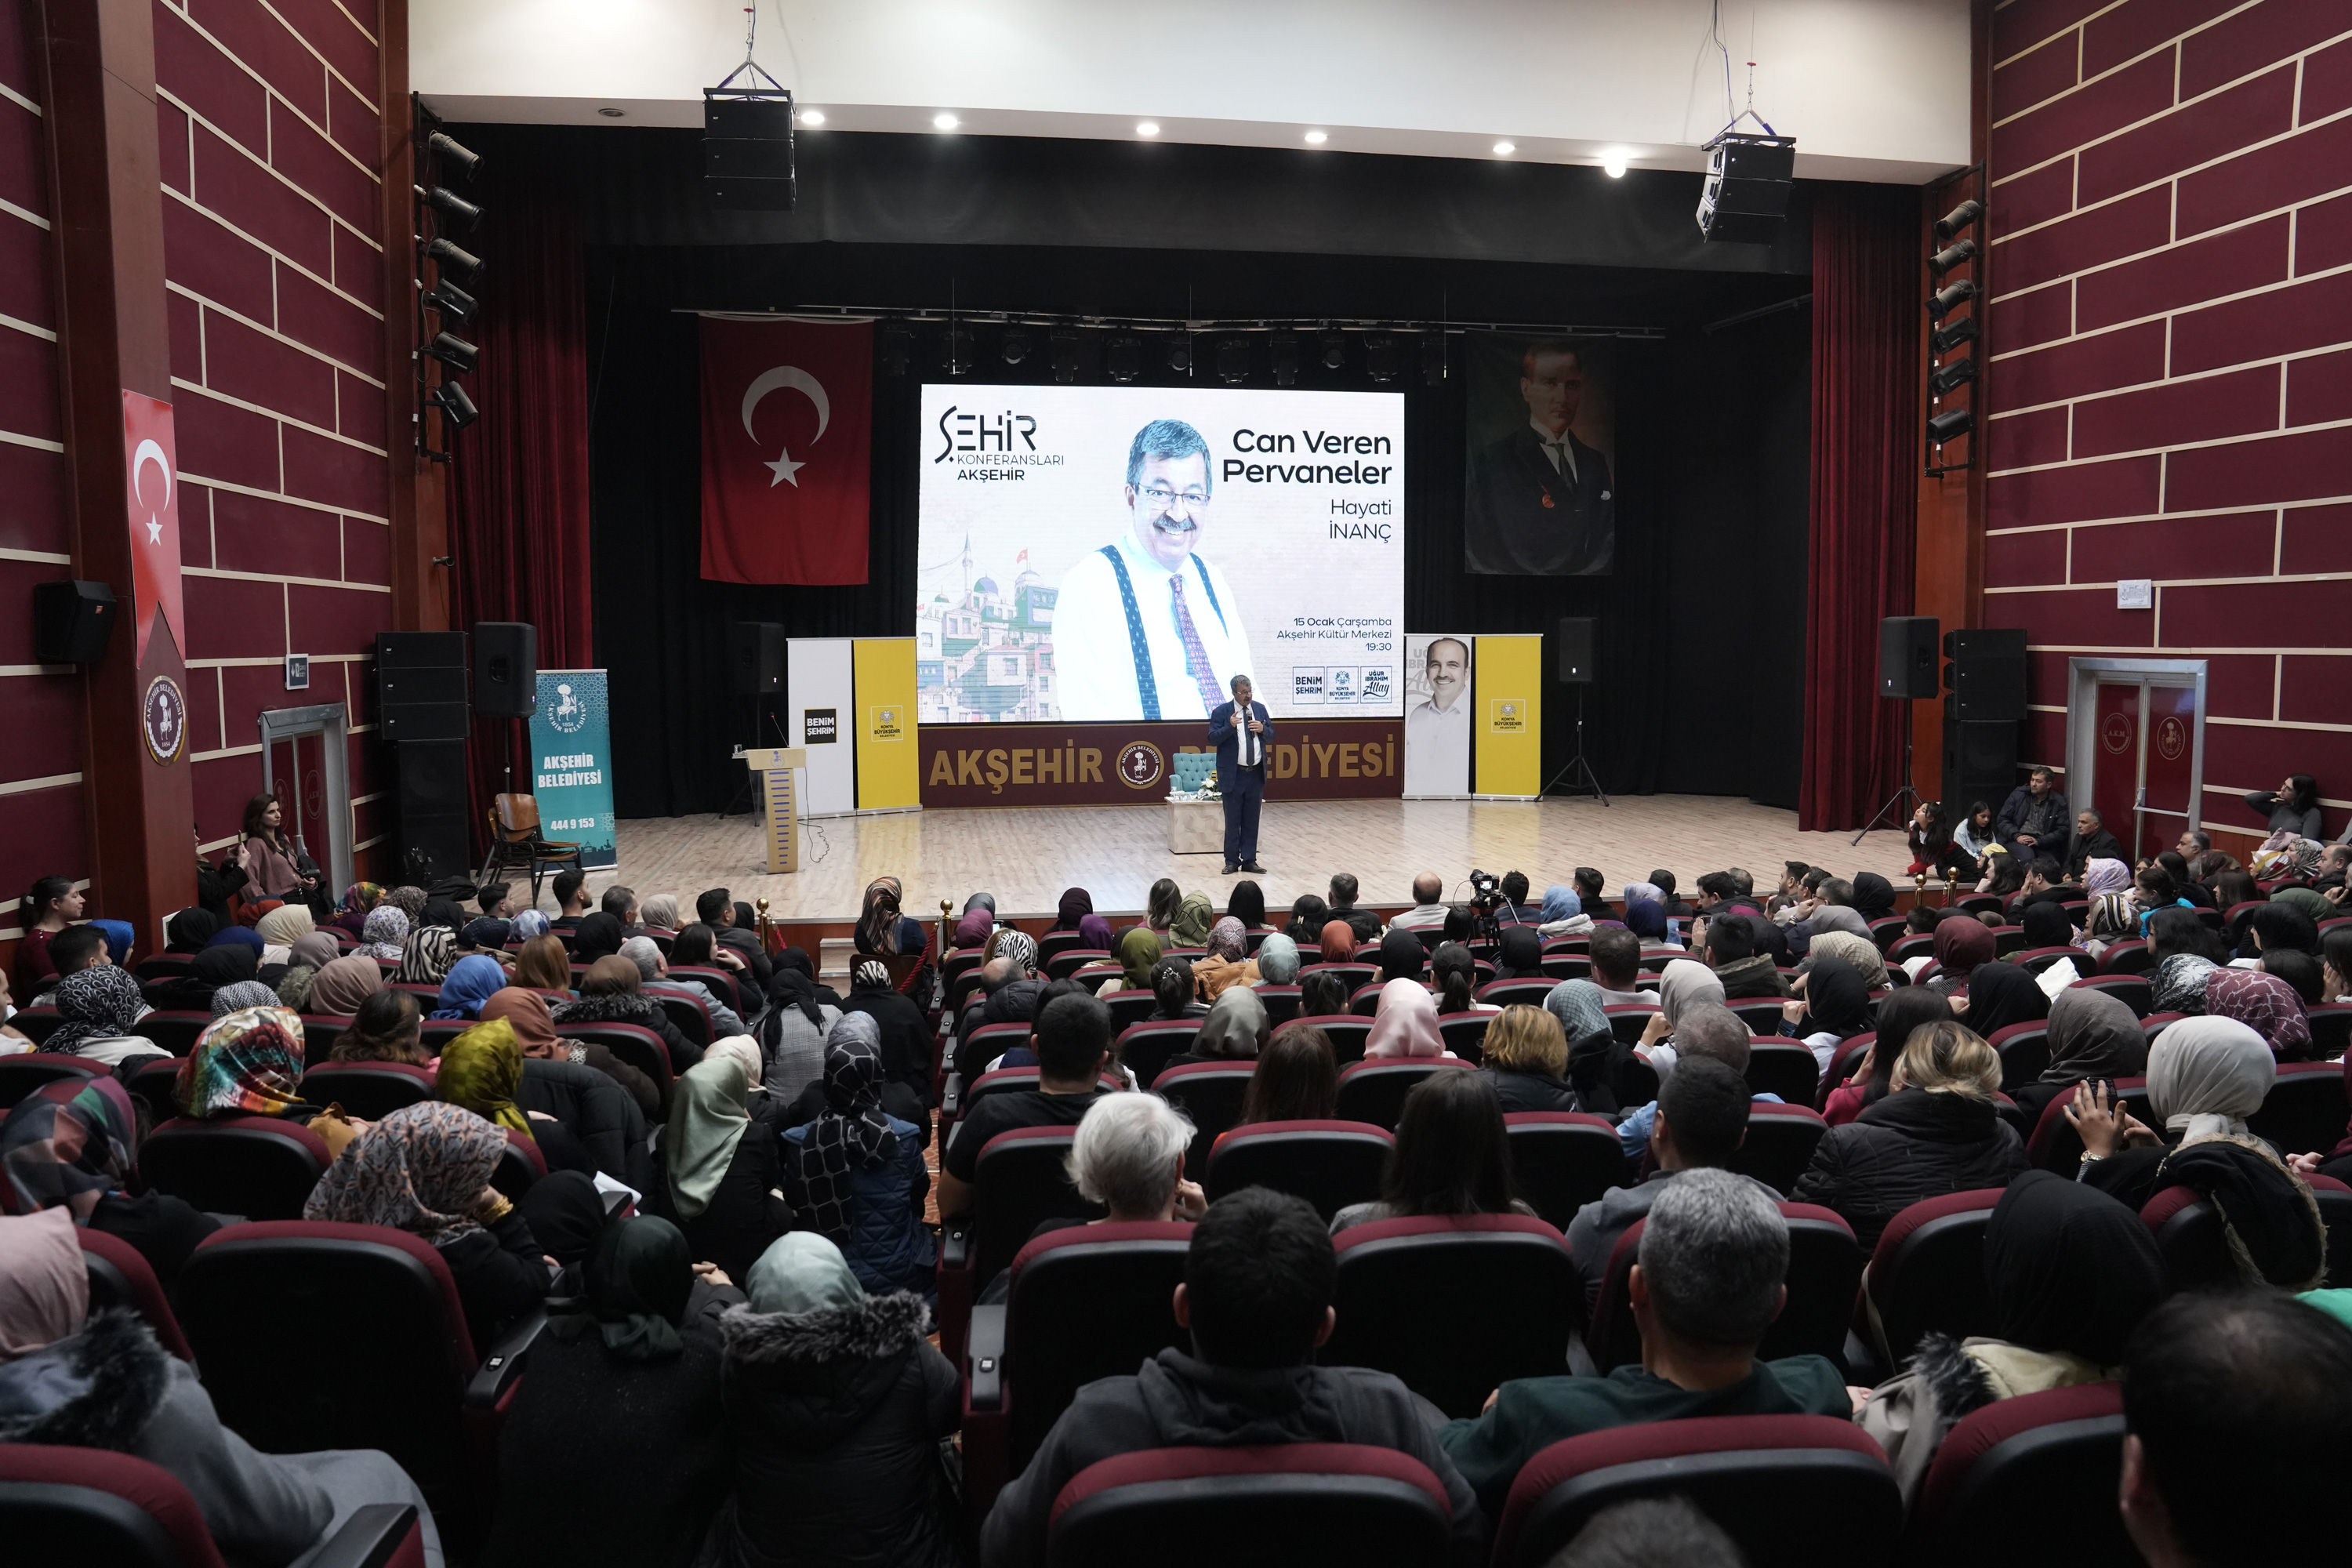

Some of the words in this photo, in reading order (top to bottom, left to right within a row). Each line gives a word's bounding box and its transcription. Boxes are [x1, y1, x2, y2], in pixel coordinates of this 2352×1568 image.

[1233, 429, 1295, 453] Can
[1302, 430, 1391, 455] Veren
[957, 454, 1064, 466] KONFERANSLARI
[957, 467, 1025, 483] AKŞEHİR
[1223, 459, 1392, 485] Pervaneler
[1331, 499, 1392, 519] Hayati
[1330, 521, 1392, 543] İNANÇ
[1307, 617, 1334, 626] Ocak
[1337, 617, 1392, 628] Çarşamba
[1276, 630, 1316, 641] Akşehir
[1318, 630, 1349, 639] Kültür
[1351, 630, 1392, 639] Merkezi
[1365, 642, 1392, 651] 19:30
[807, 717, 835, 727] BENİM
[807, 727, 835, 736] ŞEHRİM
[543, 752, 594, 771] AKŞEHİR
[928, 739, 1104, 794] AKŞEHİR
[1179, 734, 1394, 779] DİYESİ
[538, 769, 602, 788] BELEDİYESİ
[550, 819, 568, 830] 444
[570, 818, 576, 829] 9
[578, 817, 594, 828] 153
